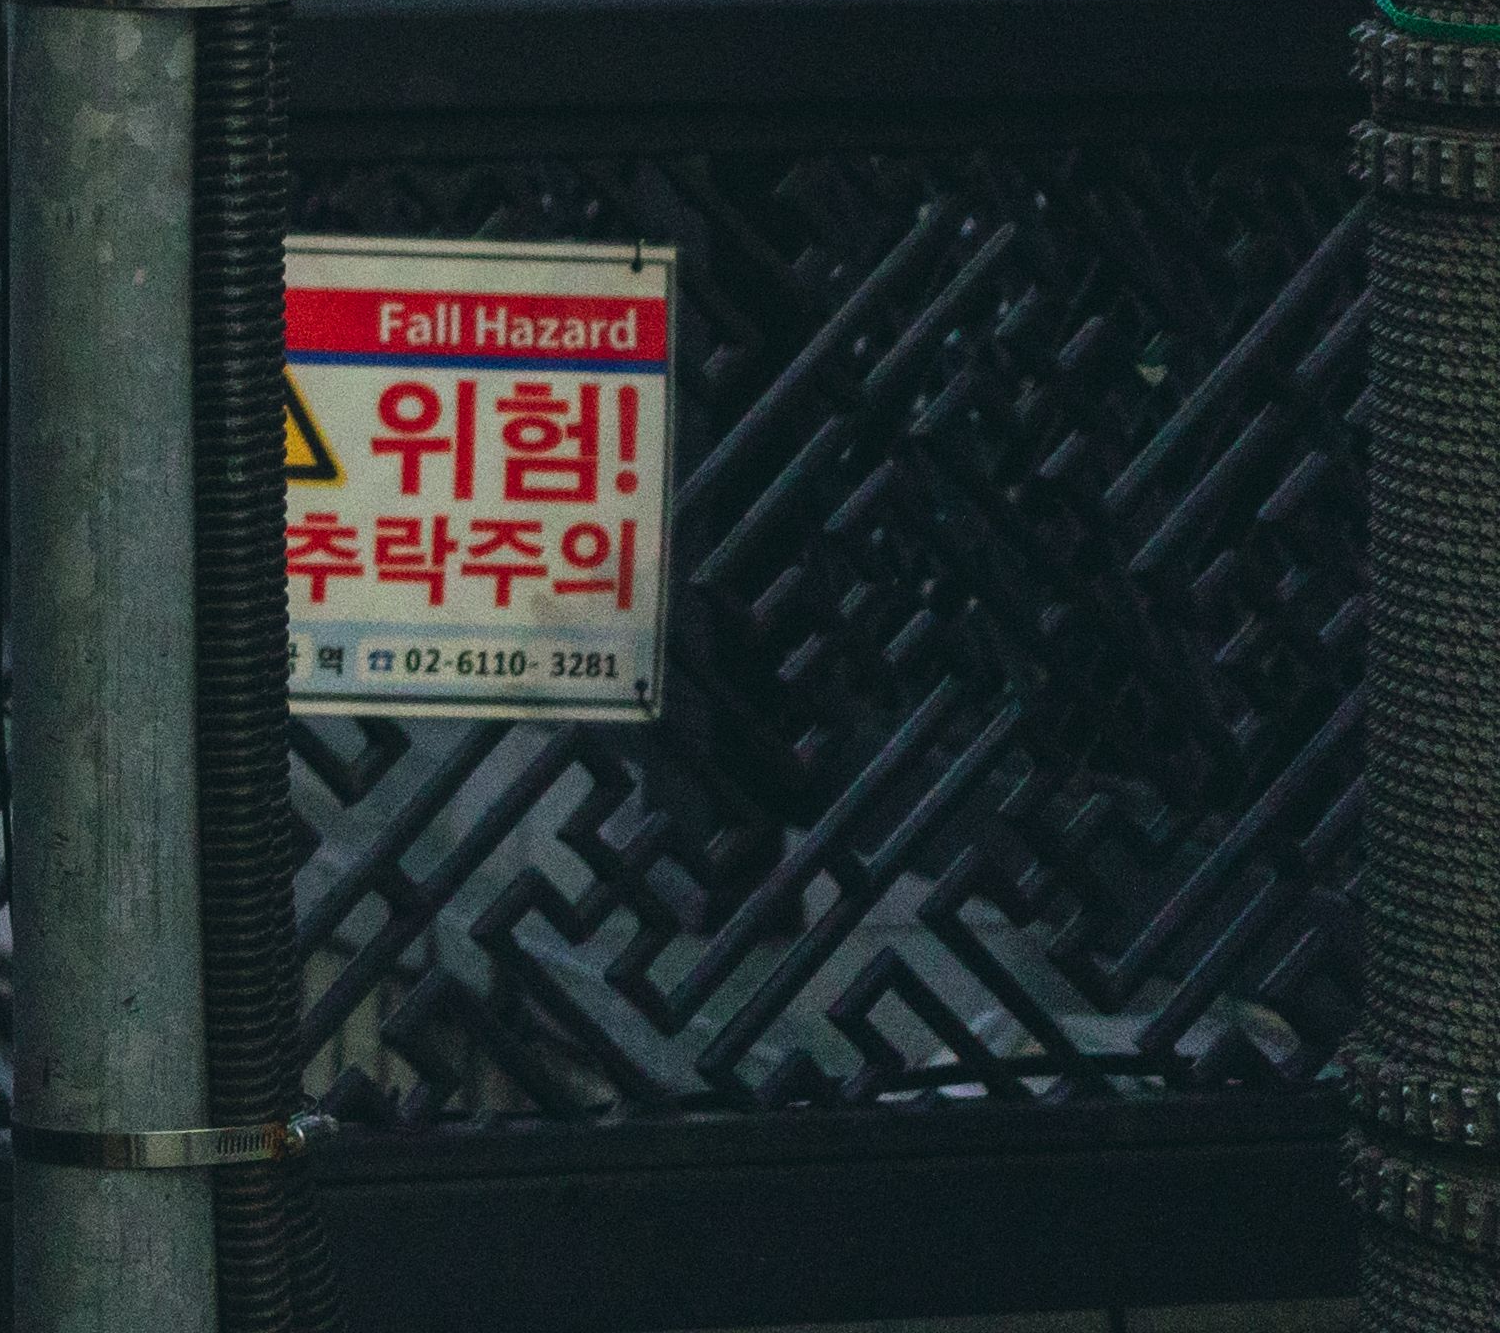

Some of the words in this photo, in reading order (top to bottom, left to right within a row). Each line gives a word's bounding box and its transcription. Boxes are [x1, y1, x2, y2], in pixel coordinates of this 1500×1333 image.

[378, 302, 462, 345] Fall
[474, 307, 638, 351] Hazard
[370, 379, 639, 505] 위험!
[285, 511, 637, 611] 추락주의
[551, 651, 619, 679] 3281
